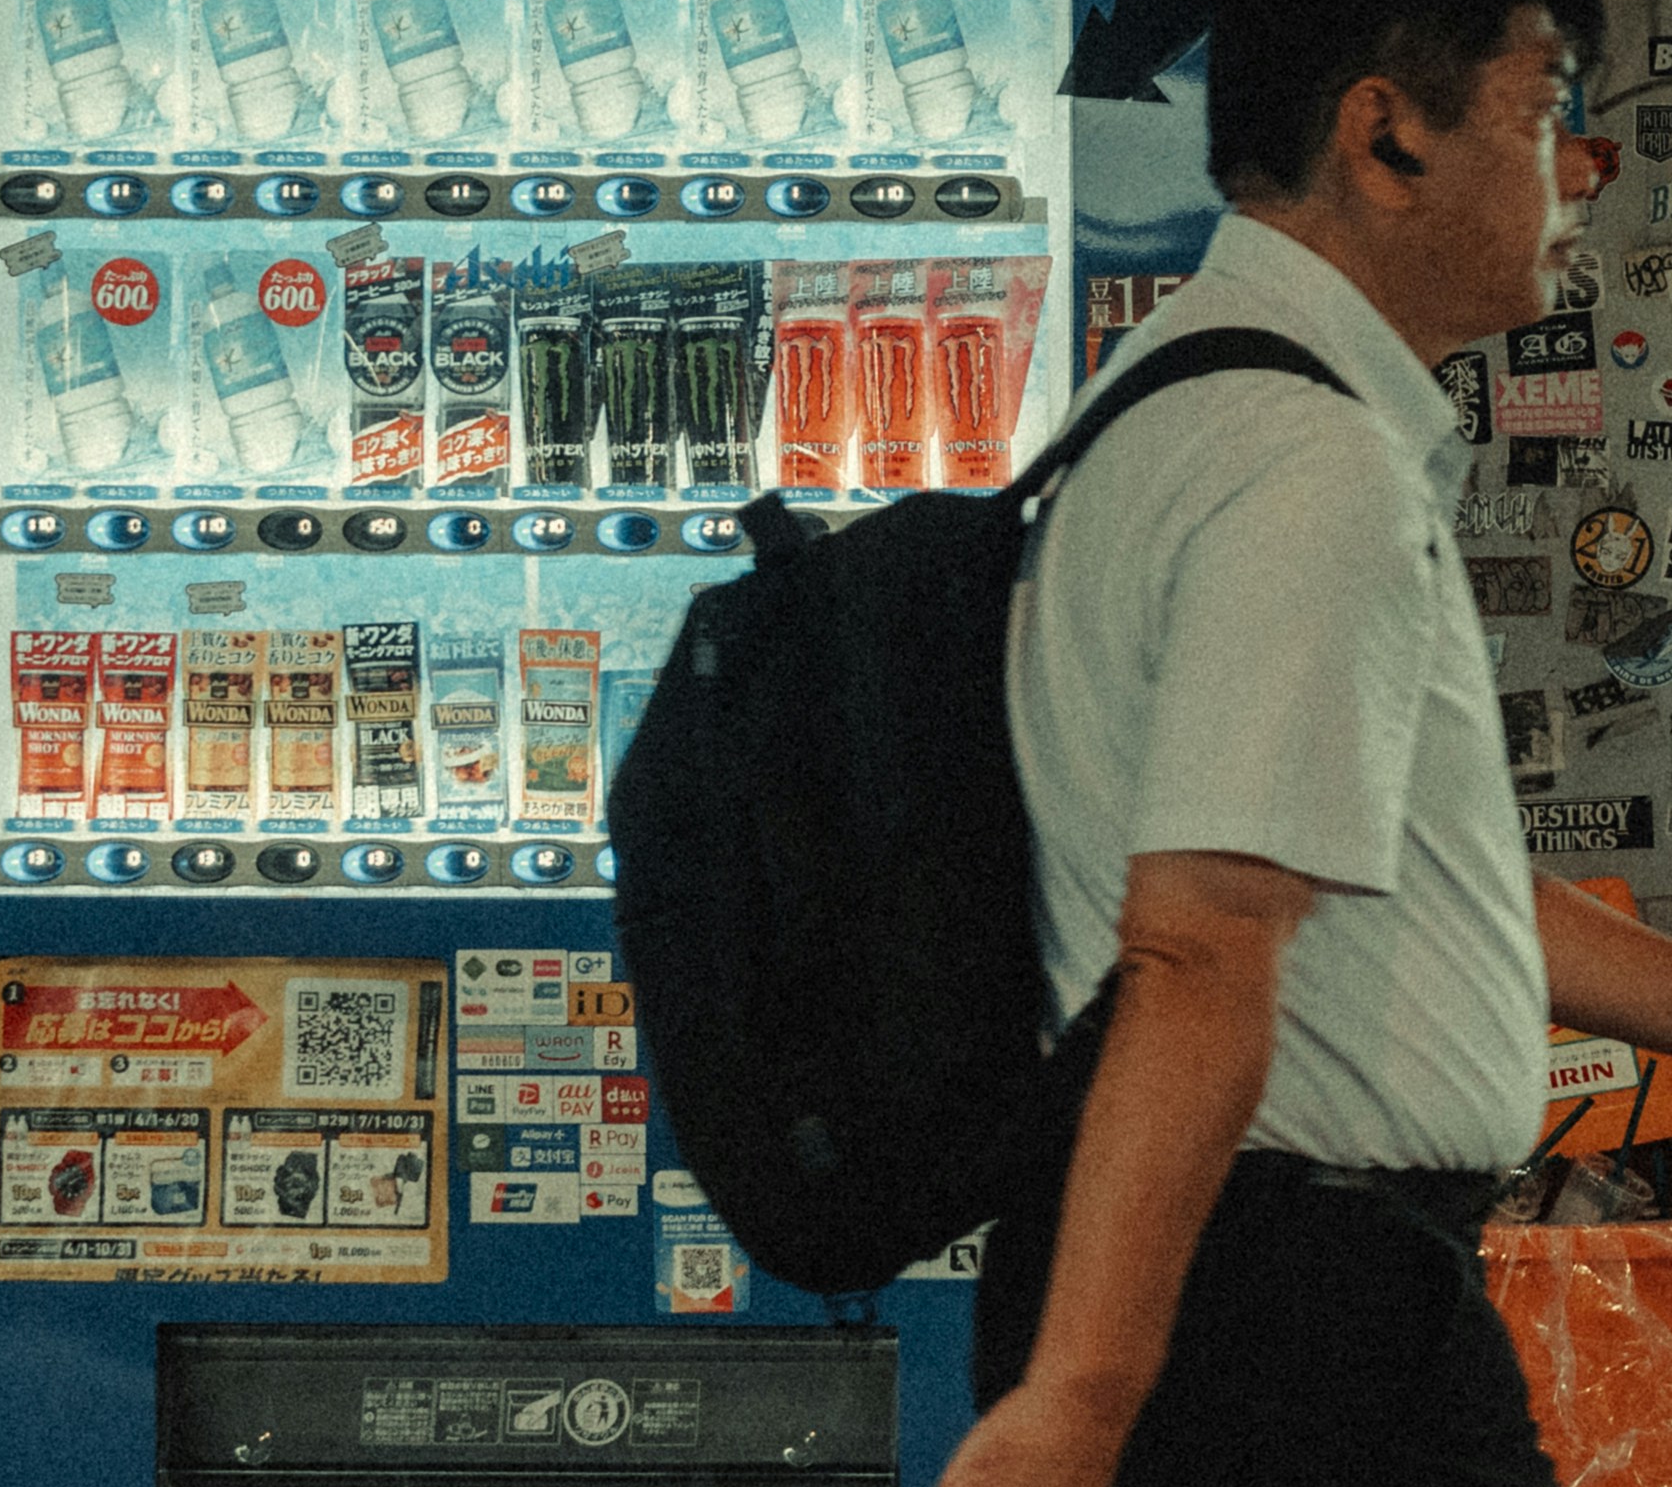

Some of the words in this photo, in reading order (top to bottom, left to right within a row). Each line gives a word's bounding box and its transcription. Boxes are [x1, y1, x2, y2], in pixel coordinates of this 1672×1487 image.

[348, 348, 417, 370] BLACK
[434, 346, 503, 368] BLACK
[1497, 371, 1601, 407] XEME
[18, 703, 85, 724] WONDA
[98, 703, 167, 724] WONDA
[187, 704, 251, 723] WONDA
[78, 991, 181, 1012] お忘れなく!
[576, 988, 630, 1016] iD
[25, 1012, 231, 1046] 応募はココから!
[466, 1083, 495, 1096] LINE
[557, 1083, 595, 1100] au
[559, 1099, 595, 1118] PAY
[134, 1112, 201, 1128] 4/1-6/30
[357, 1114, 427, 1131] 7/1-10/31
